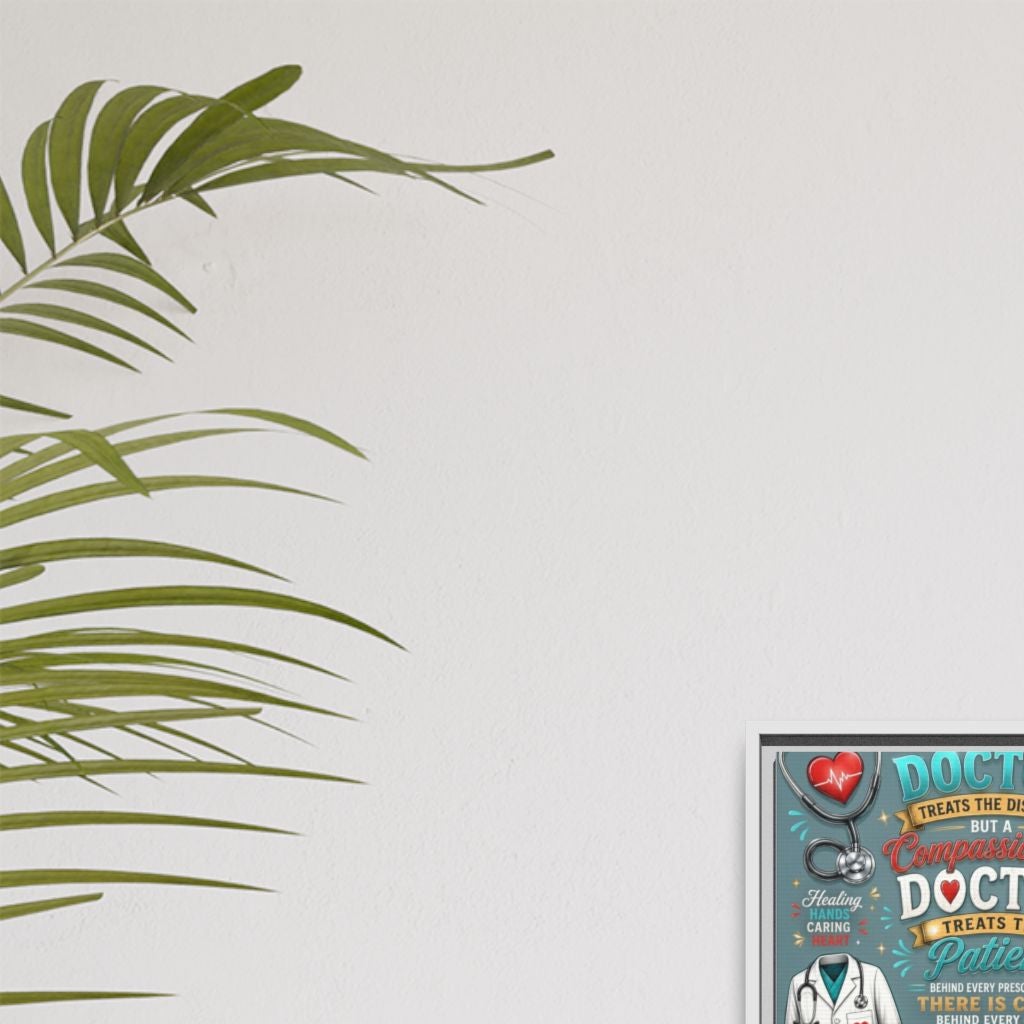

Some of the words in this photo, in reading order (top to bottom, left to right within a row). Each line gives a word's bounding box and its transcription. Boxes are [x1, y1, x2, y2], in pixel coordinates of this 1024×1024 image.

[918, 798, 970, 819] TREATS
[974, 798, 1001, 811] THE
[970, 820, 998, 833] BUT
[1002, 820, 1012, 833] A
[801, 889, 863, 912] Healing
[809, 908, 850, 920] HANDS
[806, 922, 851, 933] CARING
[942, 917, 1006, 933] TREATS
[930, 983, 964, 993] BEHIND
[966, 983, 995, 993] EVERY
[917, 996, 981, 1012] THERE
[988, 996, 1006, 1012] IS
[936, 1015, 979, 1024] BEHIND
[984, 1015, 1020, 1024] EVERY
